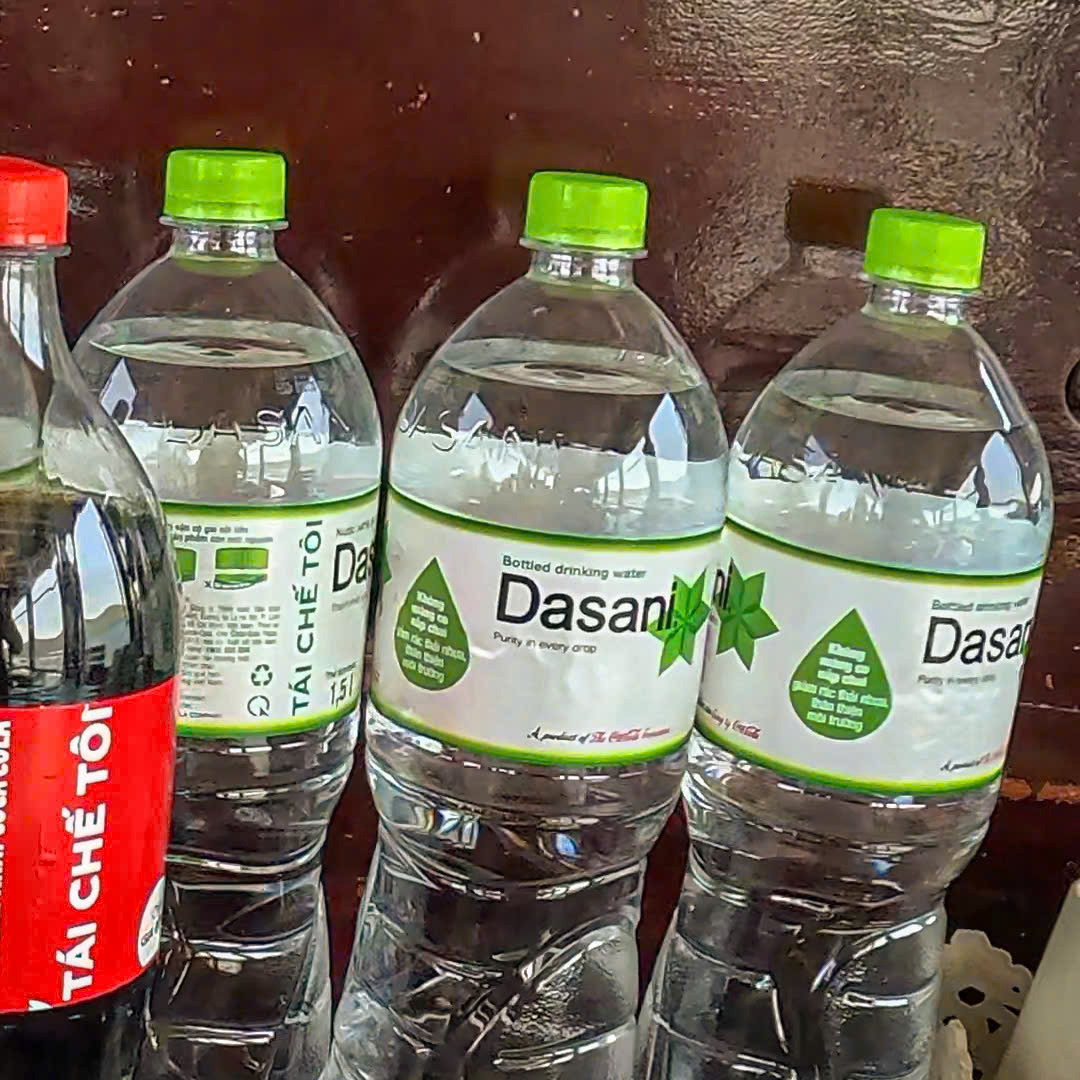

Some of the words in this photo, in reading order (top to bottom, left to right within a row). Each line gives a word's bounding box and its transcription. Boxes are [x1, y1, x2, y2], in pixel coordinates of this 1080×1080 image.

[299, 519, 323, 577] TÔI
[502, 554, 551, 573] Bottled
[554, 564, 609, 581] drinking
[292, 583, 319, 655] CHẾ
[496, 571, 677, 634] Dasani
[493, 631, 522, 647] Purity
[288, 664, 314, 717] TÁI
[61, 802, 108, 912] CHẾ
[56, 923, 97, 1002] TÁI
